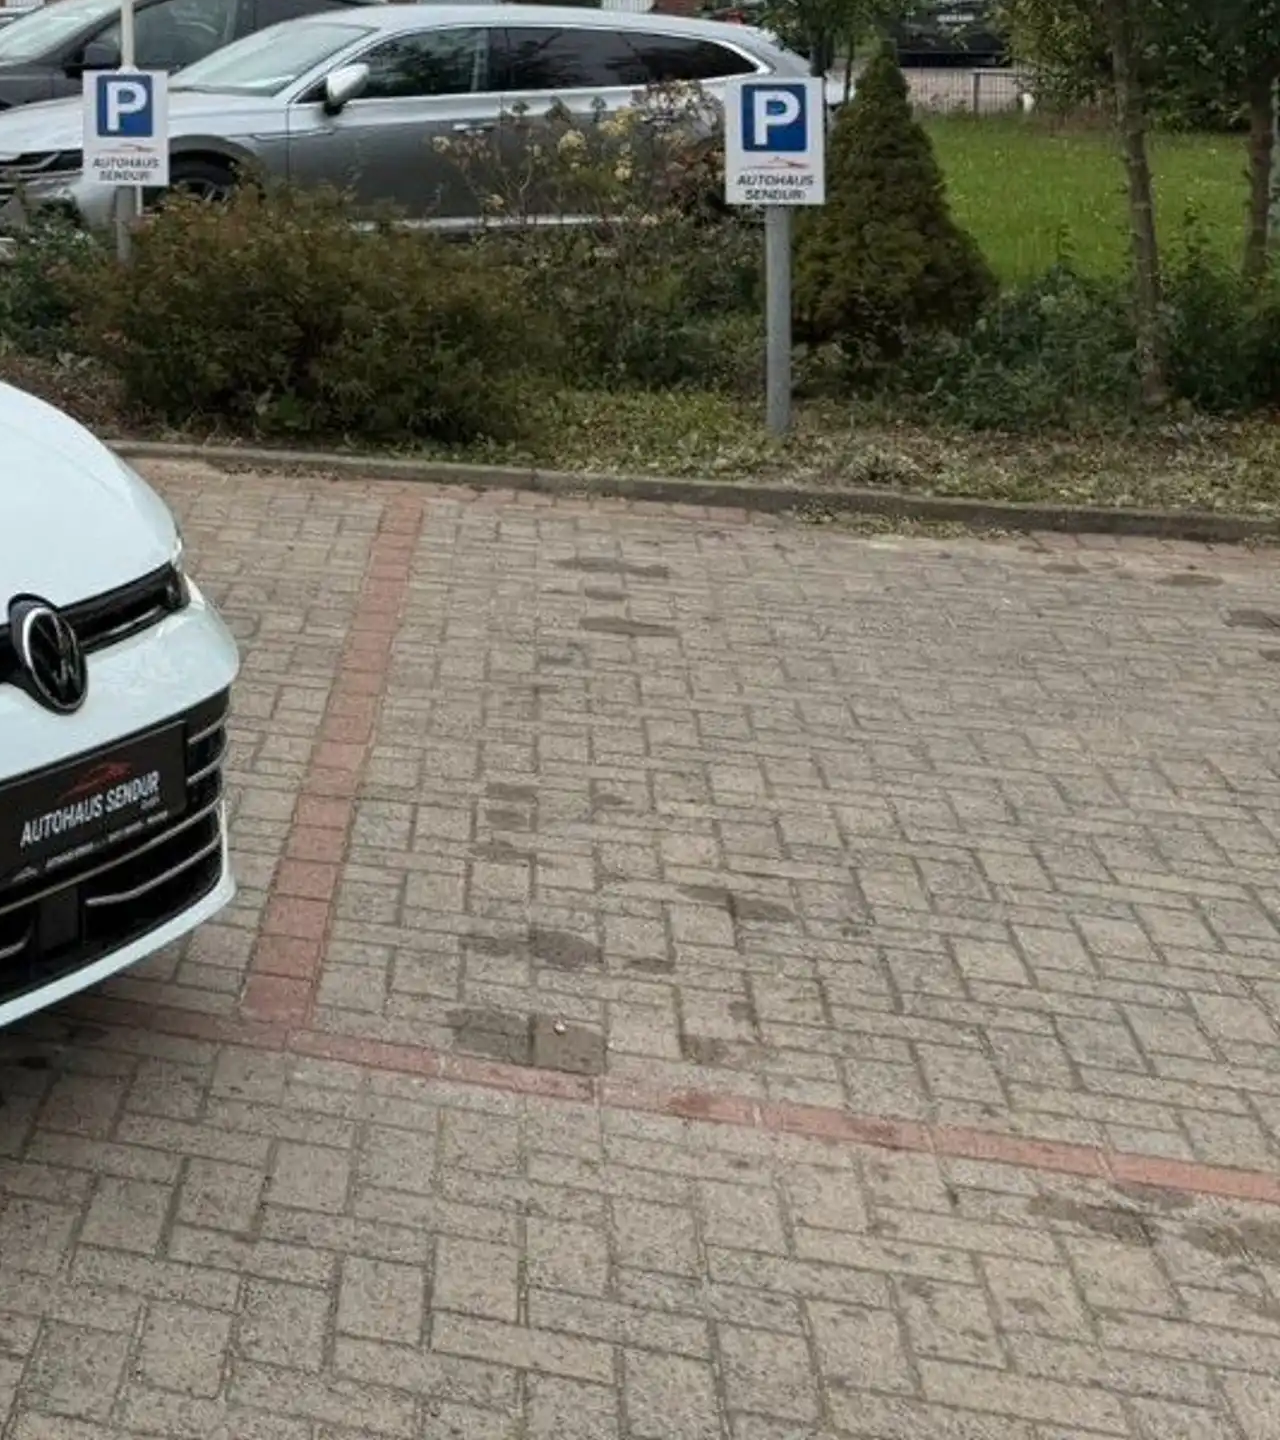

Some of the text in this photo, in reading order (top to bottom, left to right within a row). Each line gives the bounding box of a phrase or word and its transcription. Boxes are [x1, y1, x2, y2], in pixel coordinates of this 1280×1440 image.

[106, 81, 148, 132] P
[753, 90, 801, 146] P
[93, 157, 160, 168] AUTOHAUS
[738, 175, 814, 186] AUTOHAUS
[20, 794, 104, 849] AUTOHAUS
[105, 770, 161, 813] SENDUR
